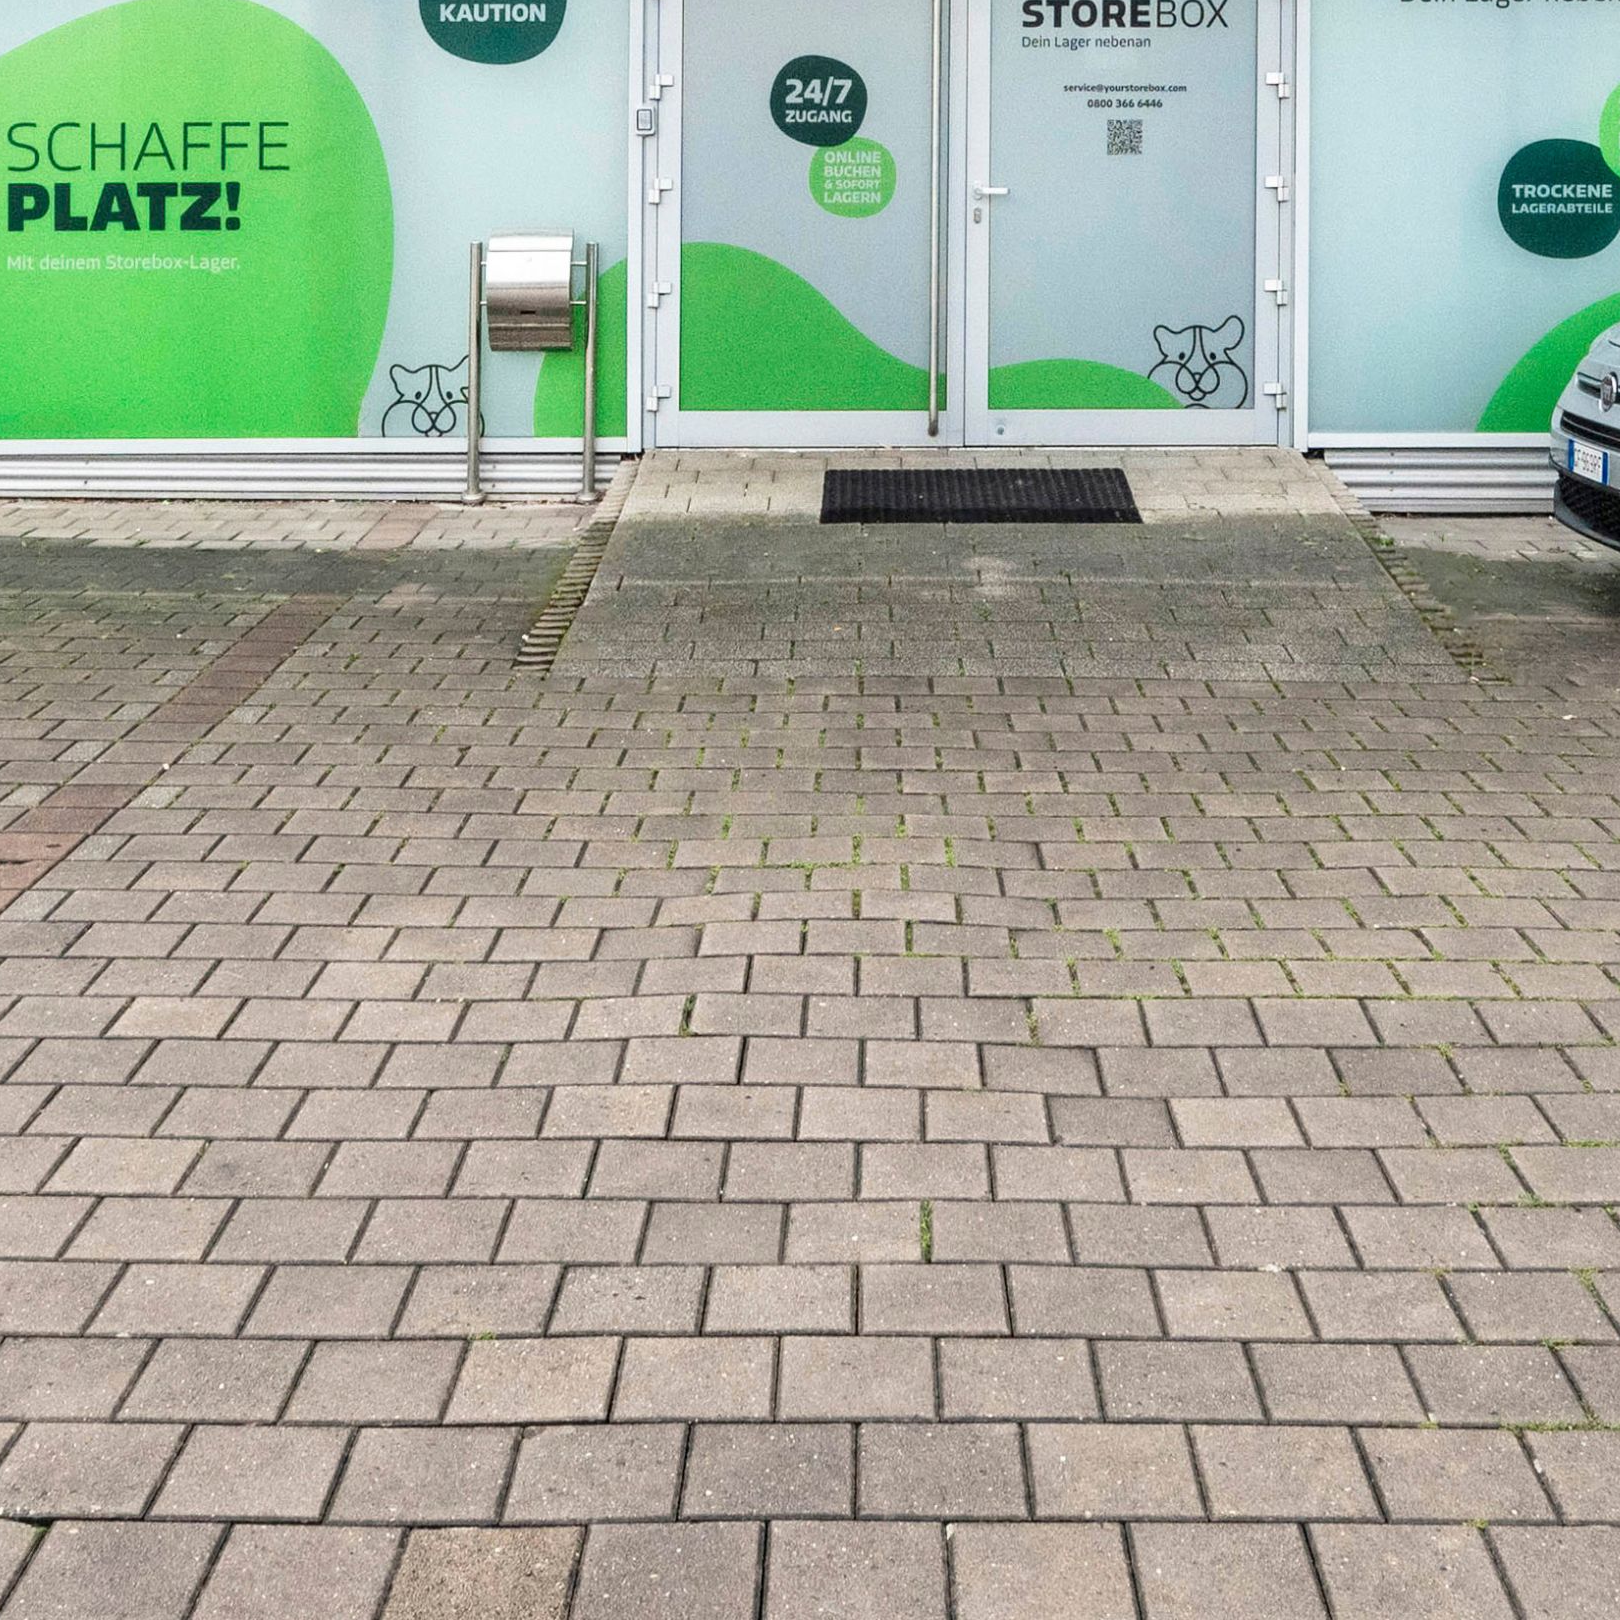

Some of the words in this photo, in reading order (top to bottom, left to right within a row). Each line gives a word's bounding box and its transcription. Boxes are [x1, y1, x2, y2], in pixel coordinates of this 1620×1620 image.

[439, 3, 546, 22] KAUTION
[1021, 36, 1051, 48] Dein
[1054, 36, 1091, 51] Lager
[1095, 35, 1151, 48] nebenan
[785, 76, 853, 106] 24/7
[1063, 83, 1187, 93] service@yourstorebox.com
[1087, 99, 1113, 108] 0800
[1116, 99, 1135, 108] 366
[1137, 99, 1163, 108] 6446
[785, 109, 853, 123] ZUGANG
[7, 121, 290, 172] SCHAFFE
[824, 150, 881, 163] ONLINE
[824, 165, 882, 177] BUCHEN
[824, 179, 833, 189] &
[836, 179, 881, 189] SOFORT
[1512, 184, 1613, 198] TROCKENE
[824, 191, 882, 203] LAGERN
[7, 181, 241, 231] PLATZ!
[1512, 203, 1613, 214] LAGERABTEILE
[7, 254, 35, 271] Mit
[39, 255, 100, 271] deinem
[105, 254, 241, 274] Storebox-Lager.
